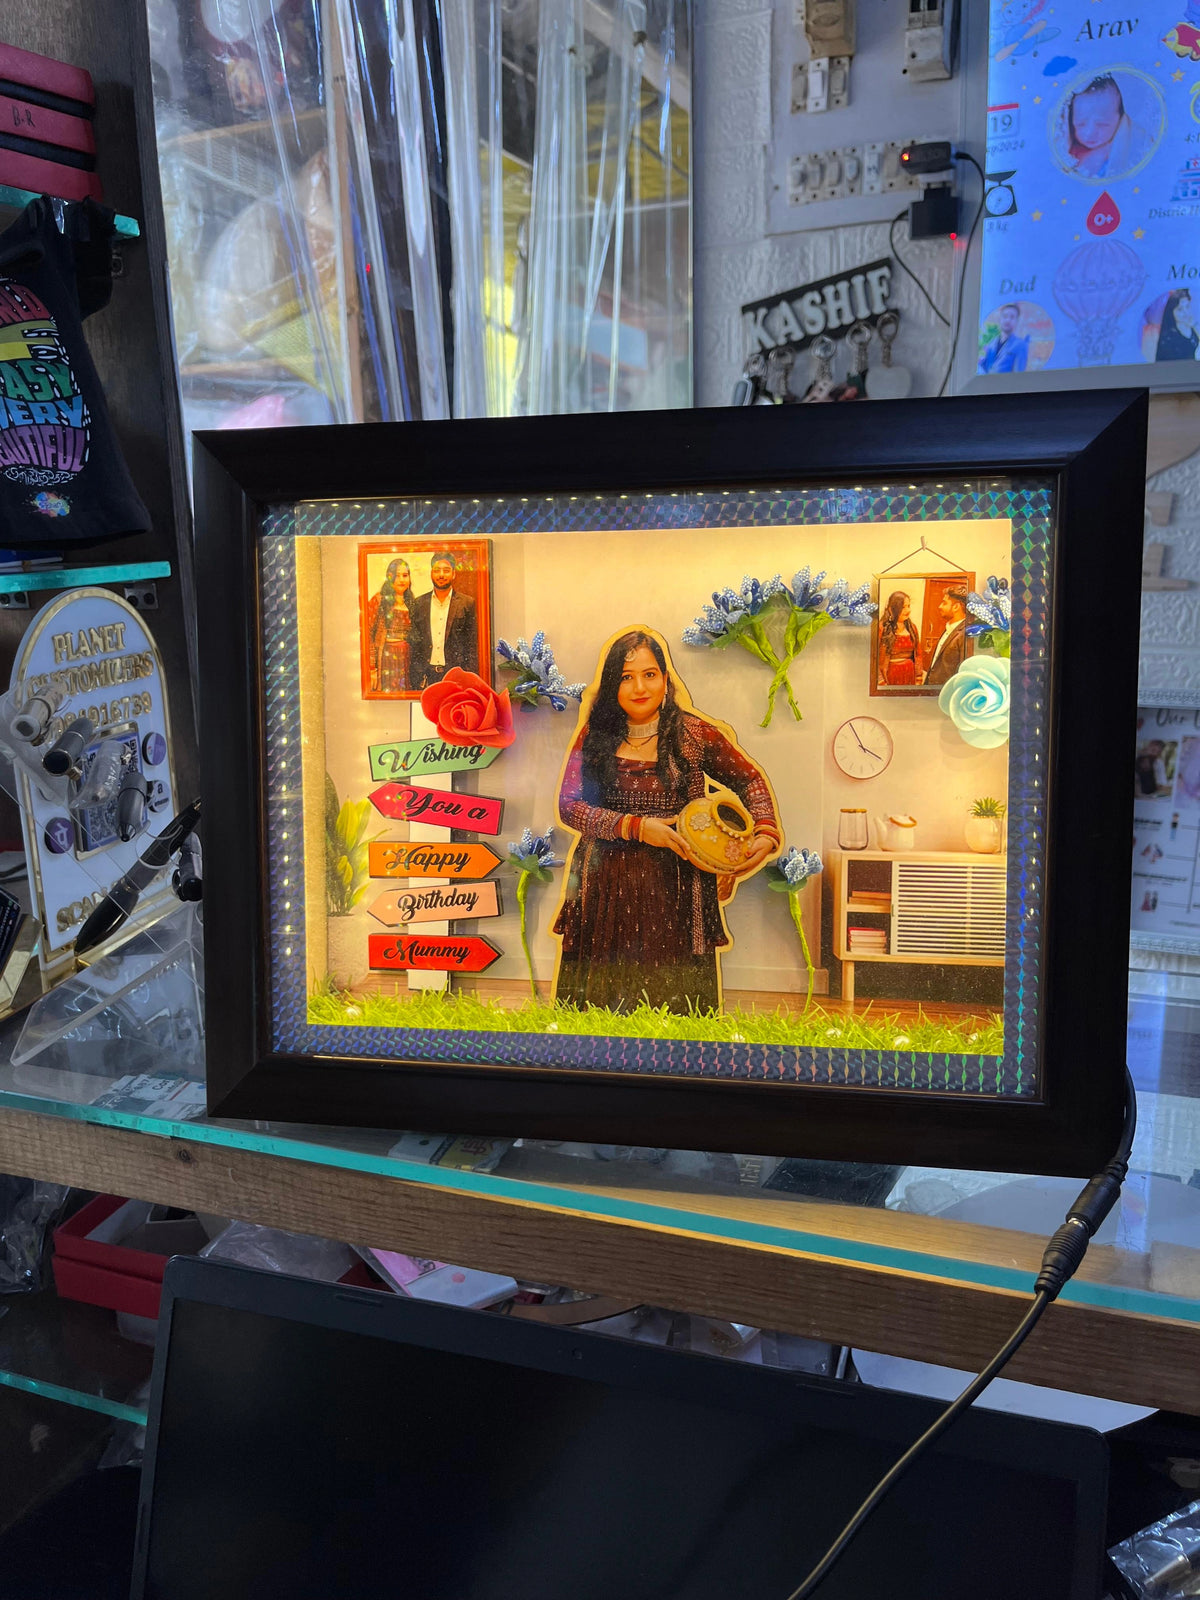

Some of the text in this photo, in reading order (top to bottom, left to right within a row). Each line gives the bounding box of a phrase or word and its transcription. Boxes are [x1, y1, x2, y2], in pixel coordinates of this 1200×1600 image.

[1075, 18, 1139, 42] Arav
[991, 114, 1013, 133] 19
[999, 275, 1037, 295] Dad
[1167, 264, 1200, 281] Mo
[743, 265, 891, 353] KASHIF
[0, 360, 74, 402] ASY
[52, 622, 126, 665] PLANET
[27, 650, 155, 698] CSTOMIZERS
[377, 742, 486, 772] Wishing
[398, 788, 488, 820] You a
[382, 845, 471, 873] Happy
[397, 887, 480, 922] Birthday
[383, 938, 471, 966] Mummy
